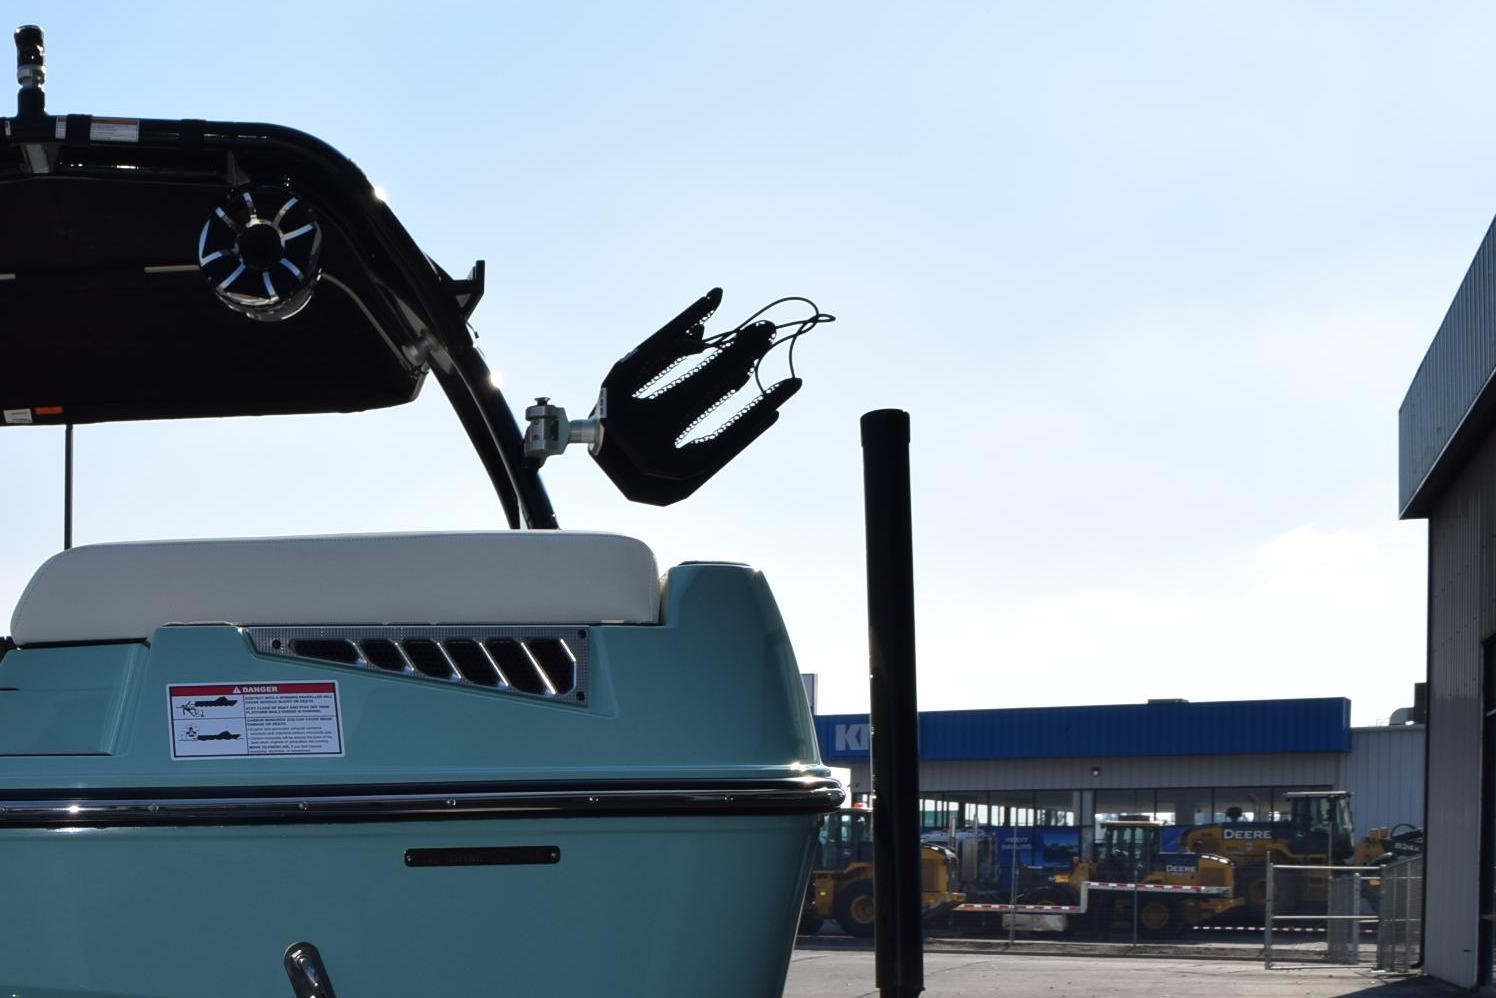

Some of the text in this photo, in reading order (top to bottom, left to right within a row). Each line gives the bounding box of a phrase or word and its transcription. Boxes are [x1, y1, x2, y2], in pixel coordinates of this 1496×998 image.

[242, 685, 278, 693] DANGER
[1223, 829, 1272, 839] DEERE
[1166, 865, 1196, 873] DEERE
